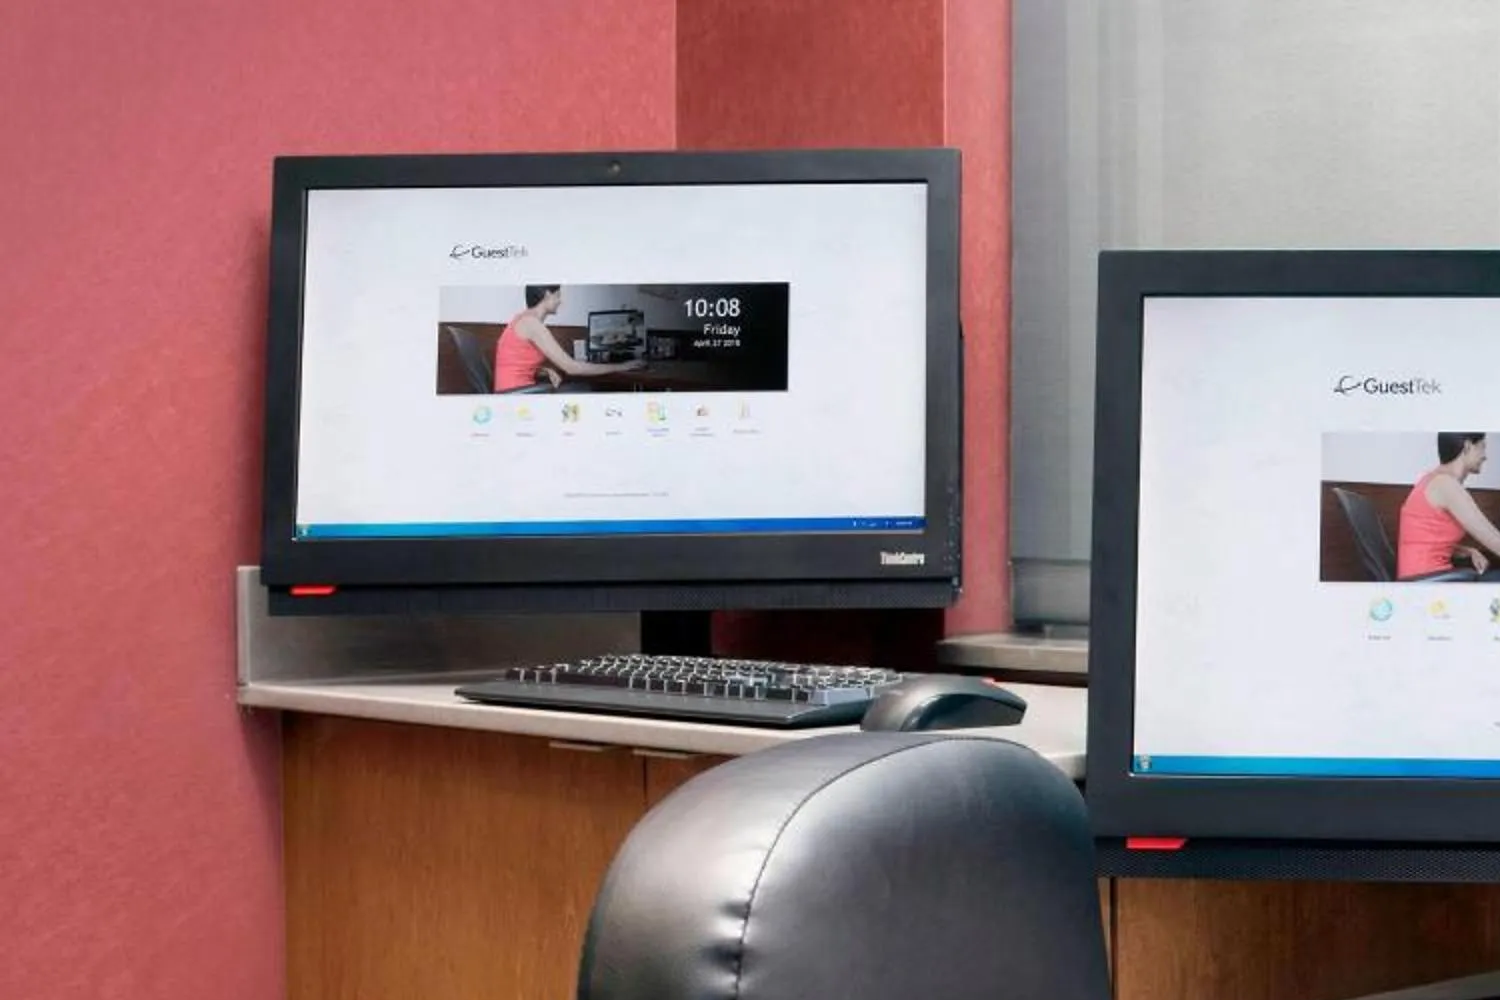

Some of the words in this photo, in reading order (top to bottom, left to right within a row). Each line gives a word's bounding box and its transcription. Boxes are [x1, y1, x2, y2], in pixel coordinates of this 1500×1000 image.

[685, 297, 741, 317] 10:08
[703, 323, 741, 337] Friday
[1363, 377, 1441, 395] GuestTek
